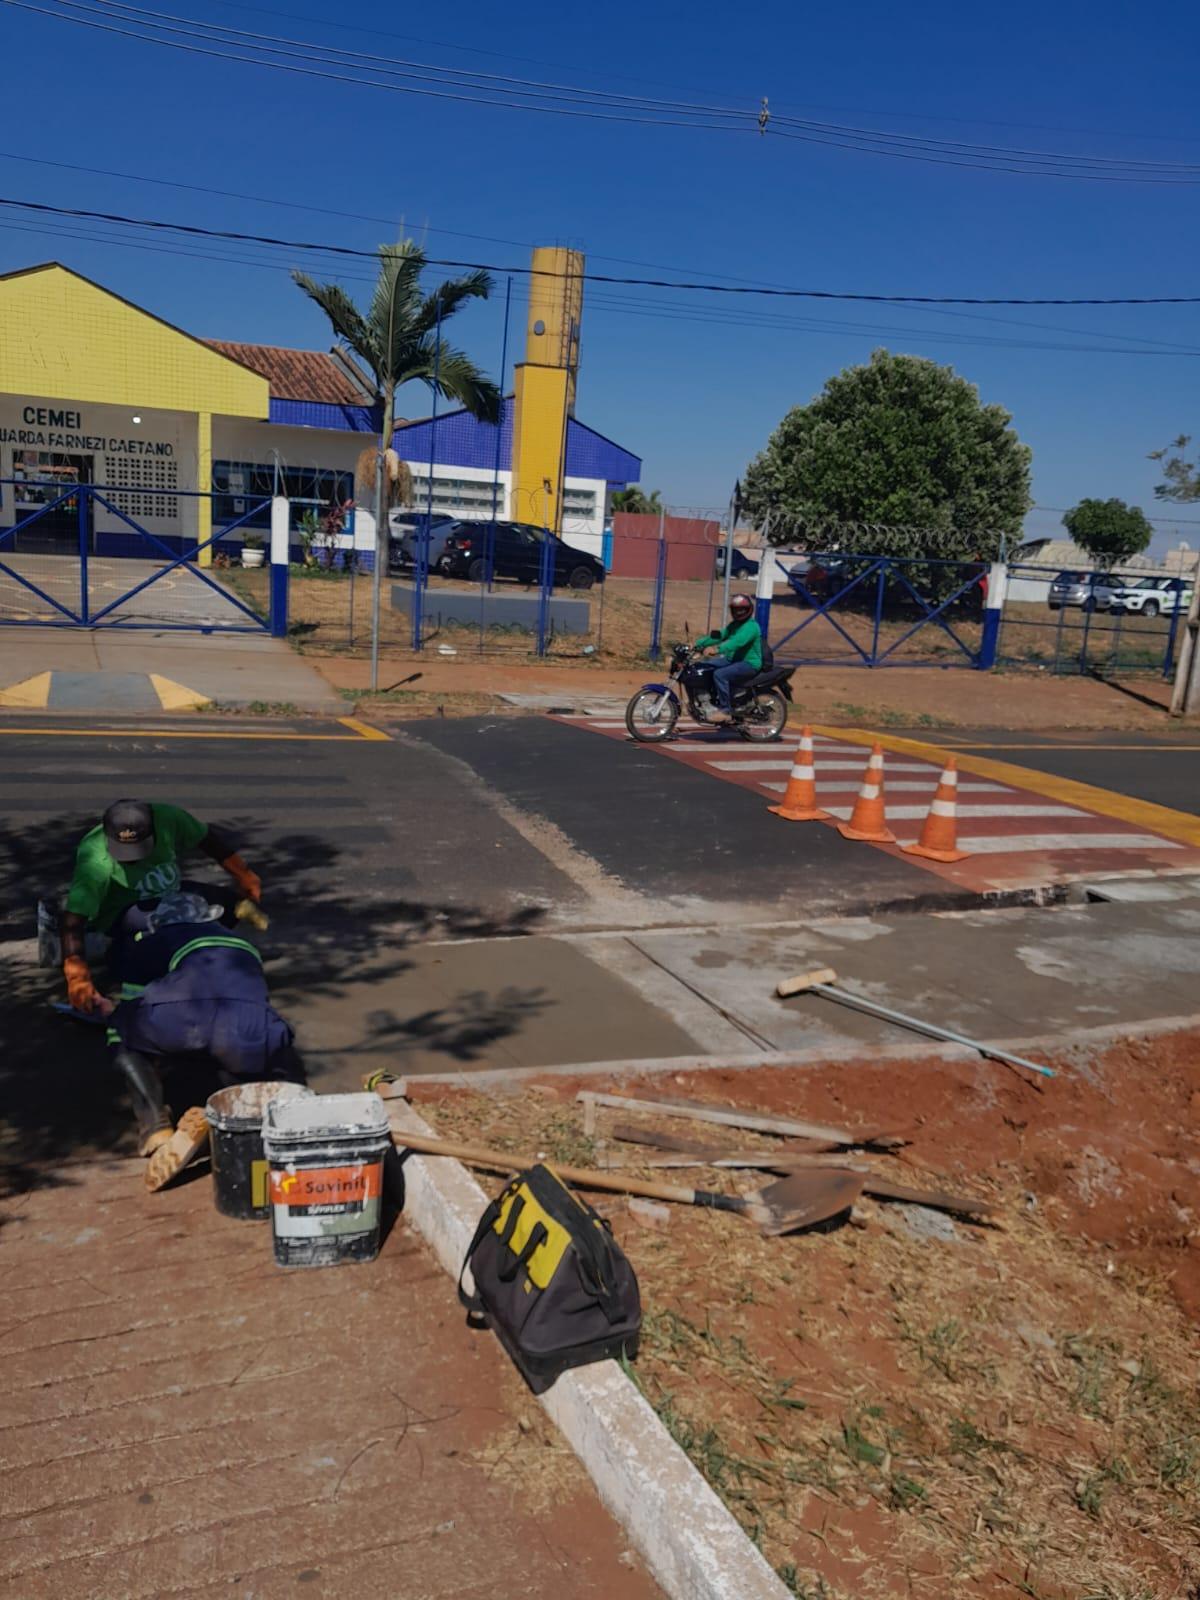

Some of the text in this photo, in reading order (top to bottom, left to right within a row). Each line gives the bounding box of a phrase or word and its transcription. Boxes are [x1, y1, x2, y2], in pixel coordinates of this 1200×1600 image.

[23, 406, 81, 429] CEMEI
[49, 433, 106, 451] FARNEZI
[109, 438, 173, 457] CAETANO
[305, 1176, 366, 1194] Suvinil
